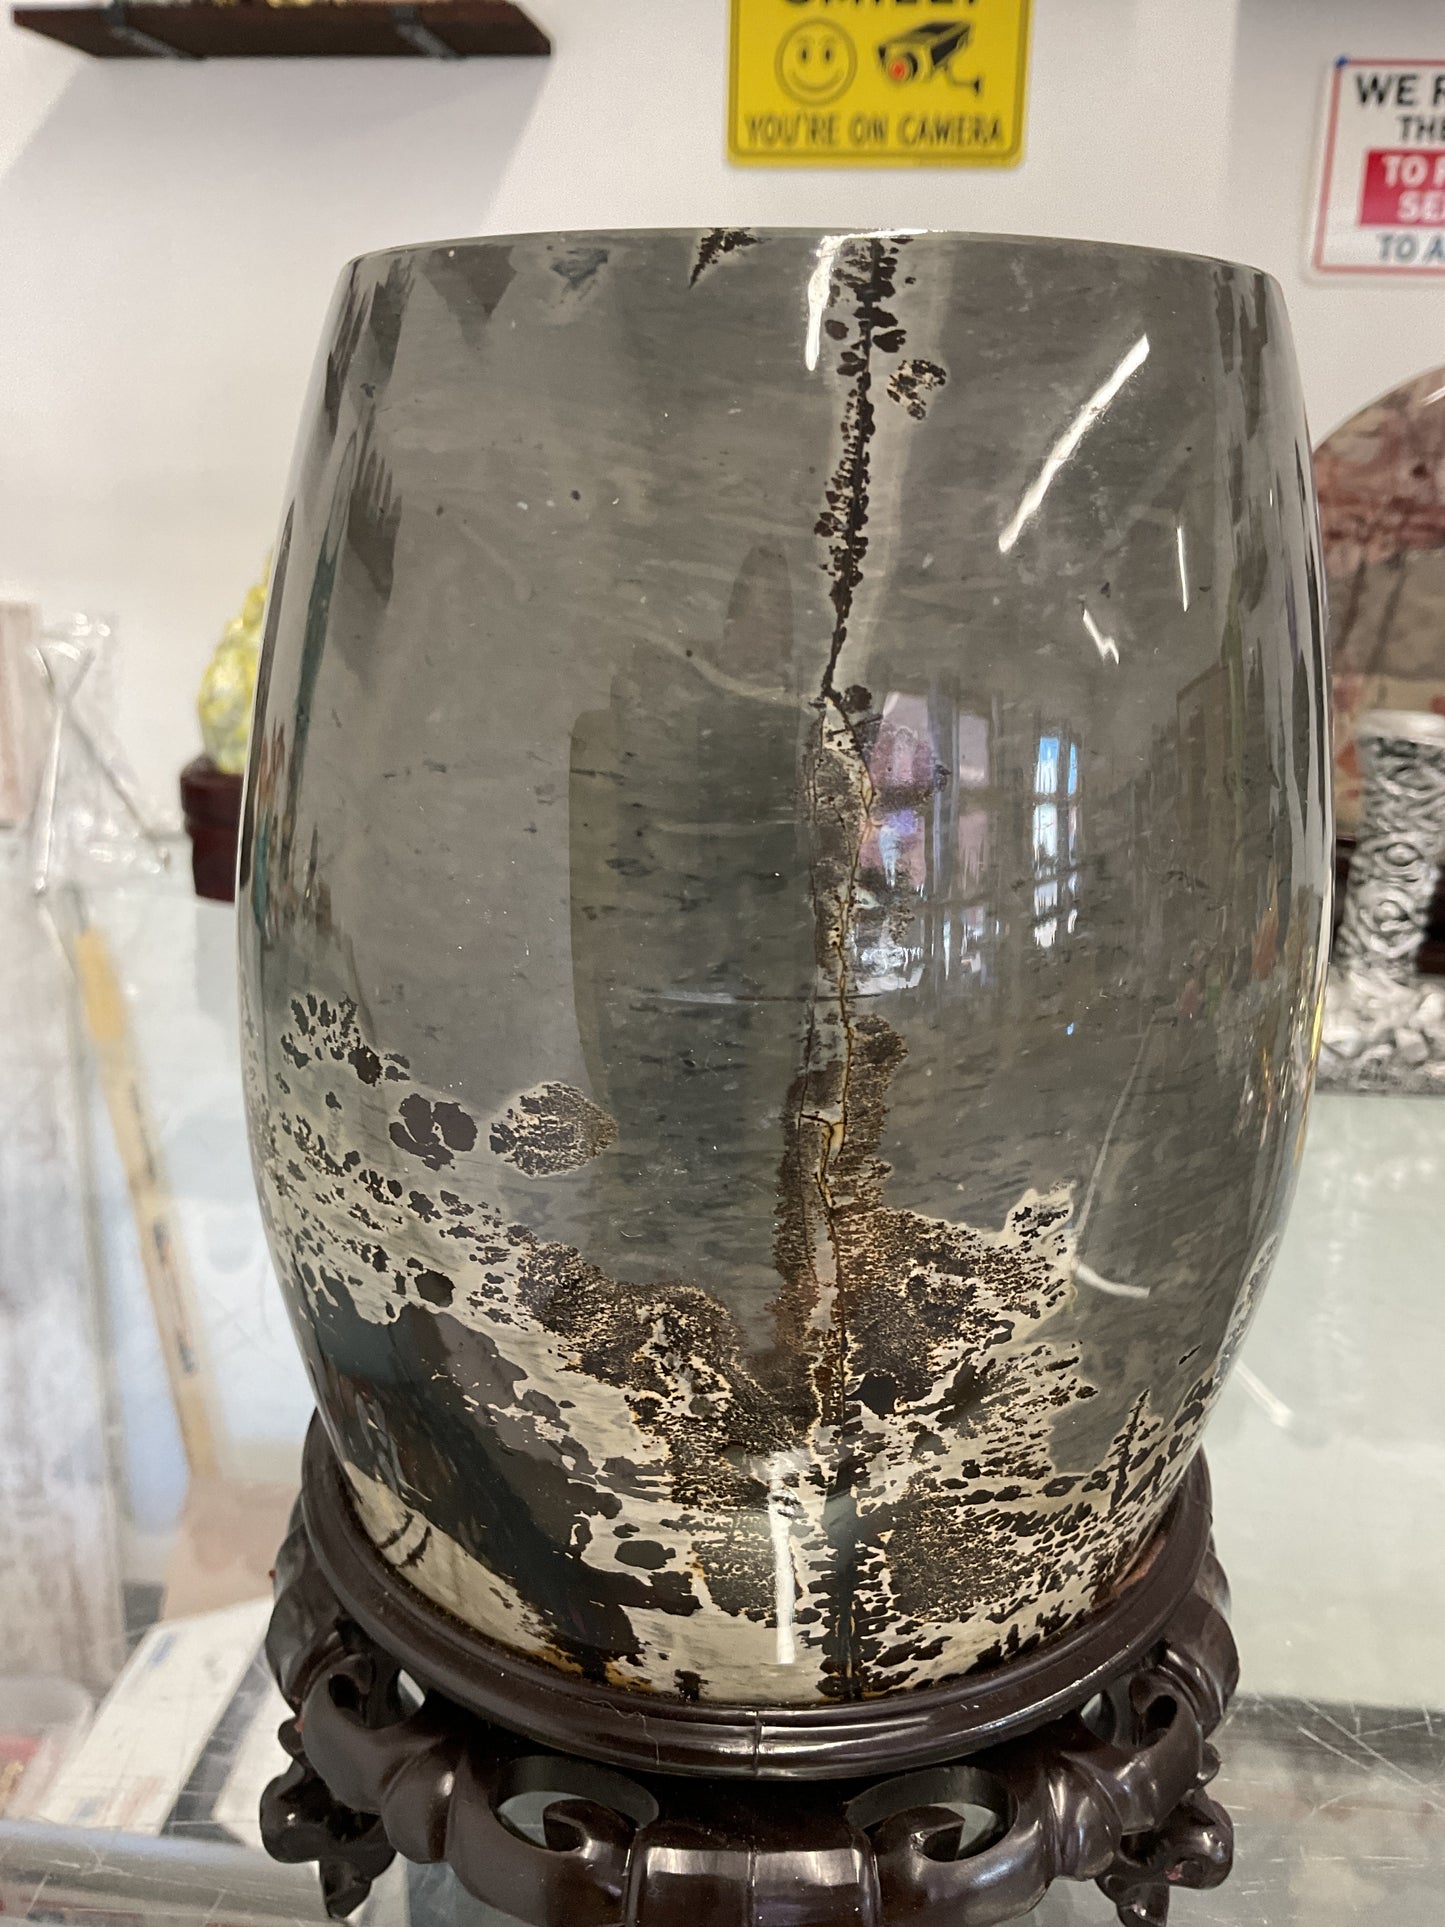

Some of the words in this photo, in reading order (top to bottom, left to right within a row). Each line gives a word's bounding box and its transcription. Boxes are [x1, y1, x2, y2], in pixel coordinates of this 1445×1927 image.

[1356, 74, 1416, 106] WE
[747, 115, 838, 146] YOU'RE
[851, 115, 887, 145] ON
[899, 114, 1002, 146] CAMERA
[1382, 155, 1427, 187] TO
[1380, 233, 1417, 261] TO
